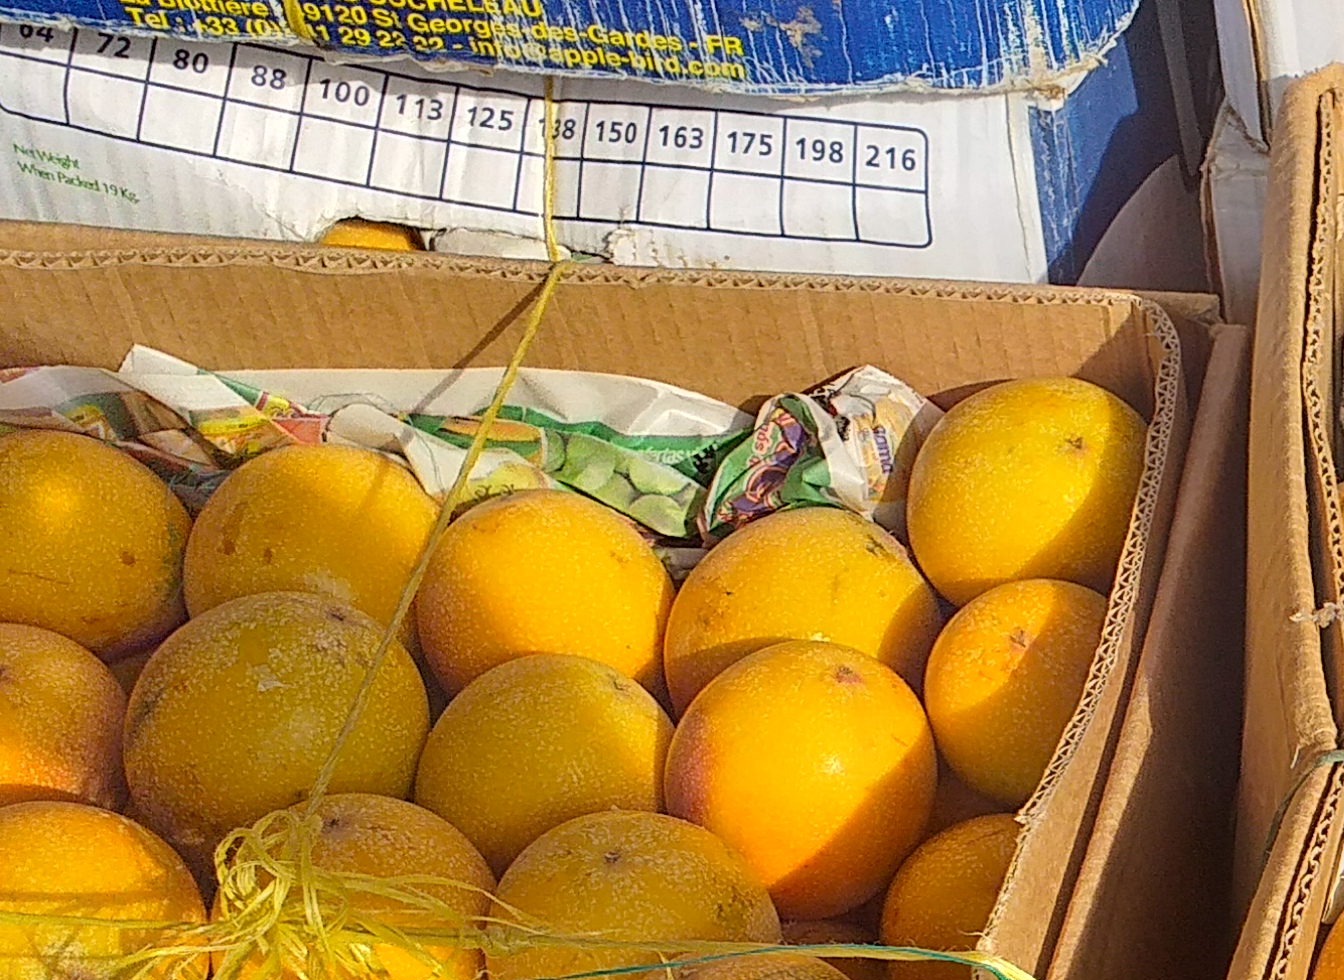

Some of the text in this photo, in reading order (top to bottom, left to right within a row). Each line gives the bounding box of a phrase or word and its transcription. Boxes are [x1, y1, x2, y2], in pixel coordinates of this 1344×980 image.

[338, 26, 372, 46] 29
[376, 30, 408, 48] 22
[407, 13, 682, 51] Georges-des-Gardes
[706, 34, 745, 56] FR
[98, 32, 132, 58] 72
[172, 49, 209, 73] 80
[251, 65, 287, 90] 88
[320, 78, 371, 106] 100
[395, 93, 444, 122] 113
[466, 106, 513, 132] 125
[595, 119, 638, 145] 150
[657, 125, 705, 150] 163
[726, 131, 774, 157] 175
[795, 137, 845, 165] 198
[865, 144, 918, 172] 216
